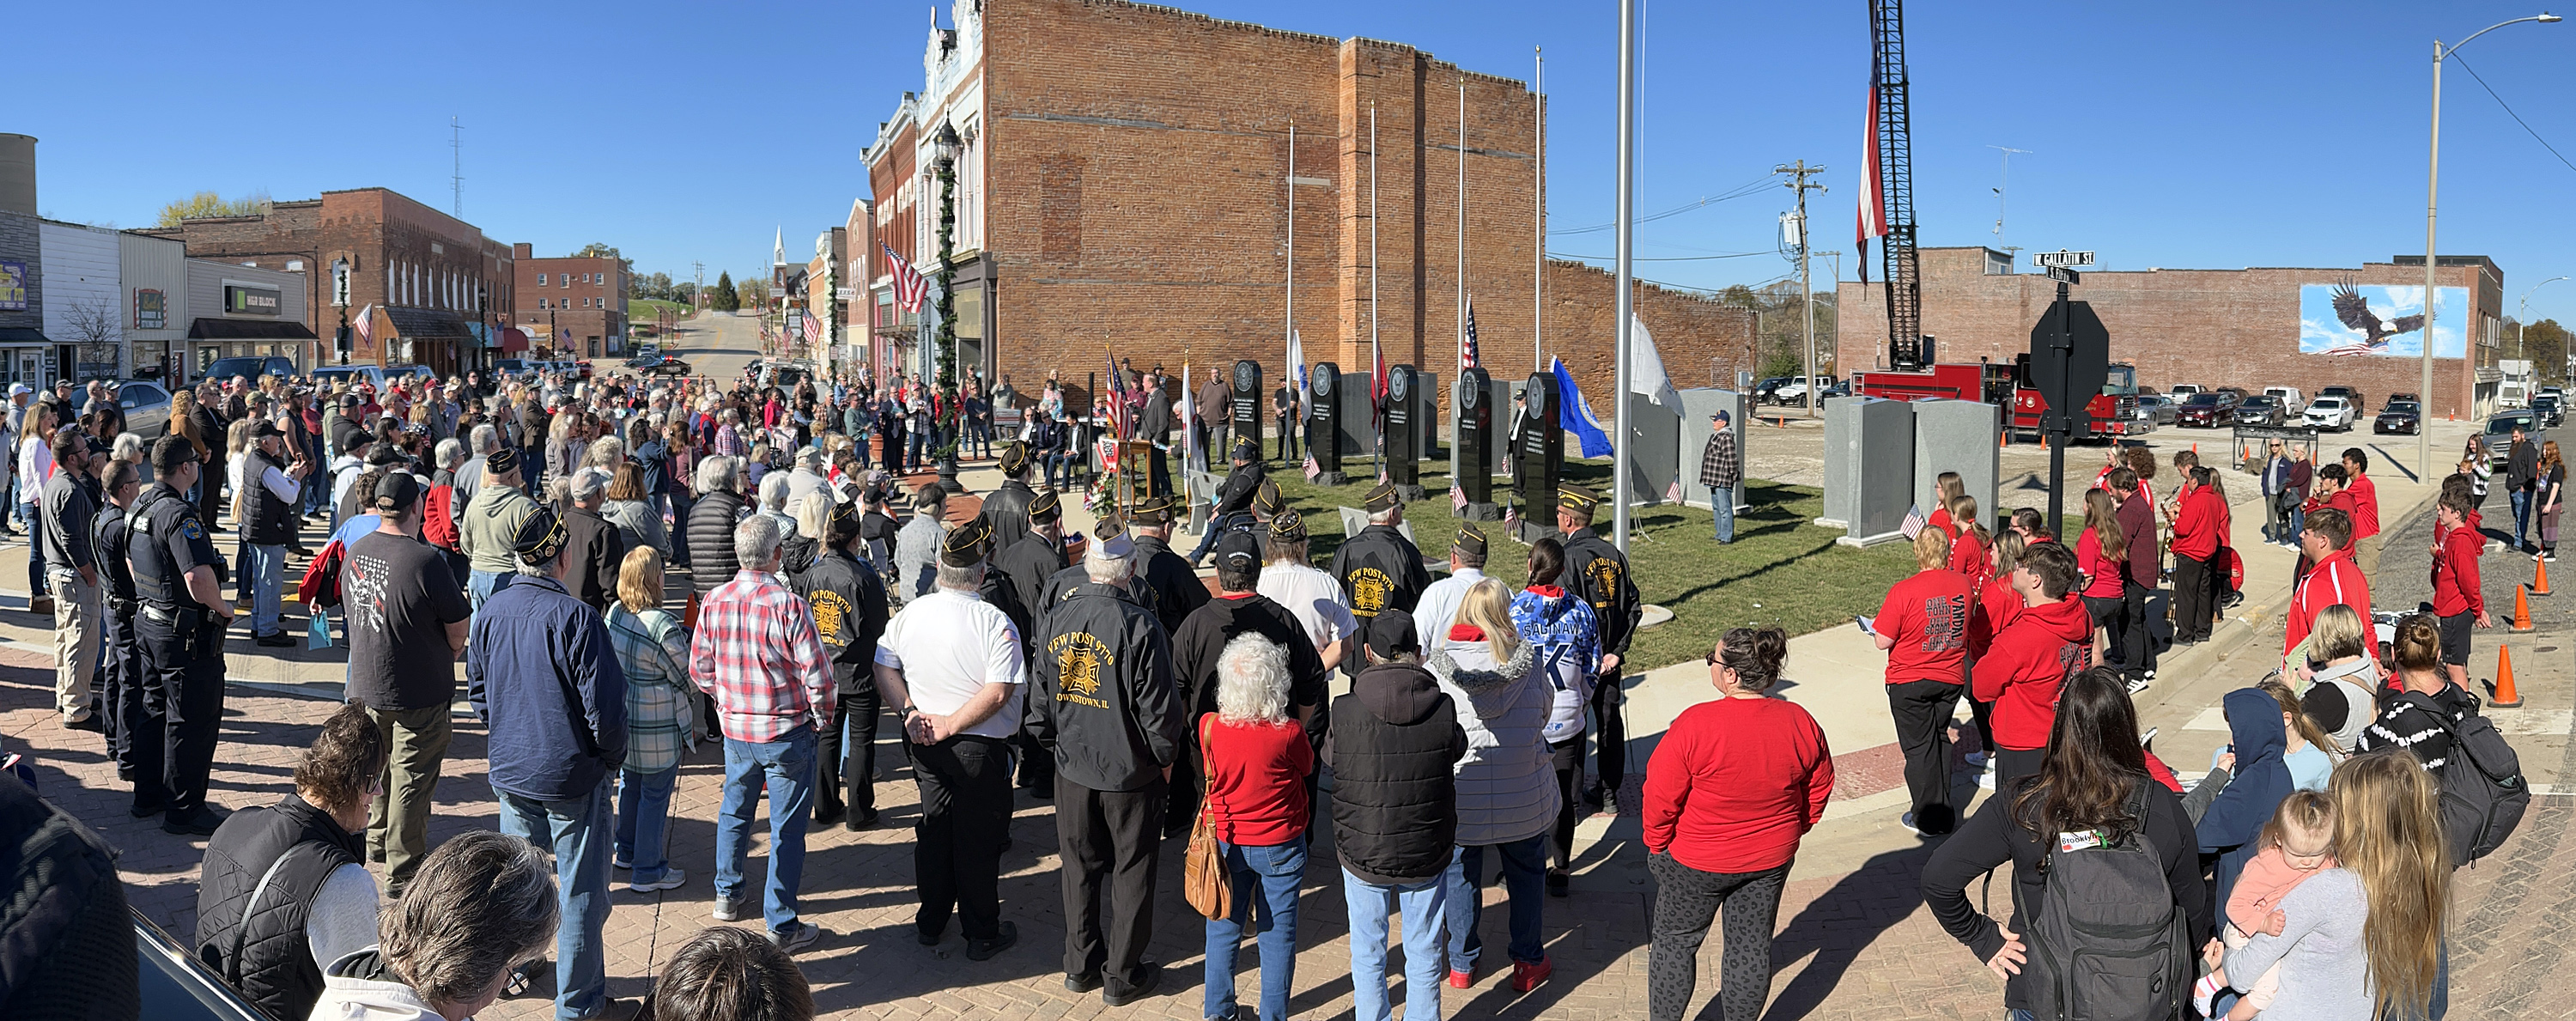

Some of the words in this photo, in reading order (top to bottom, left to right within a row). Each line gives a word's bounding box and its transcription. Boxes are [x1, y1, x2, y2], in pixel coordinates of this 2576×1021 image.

[2044, 252, 2081, 265] GALLATIN
[258, 296, 276, 307] BLOCK
[1347, 568, 1363, 583] VFW
[1363, 567, 1382, 580] POST
[1382, 574, 1395, 592] 9770
[819, 589, 837, 602] POST
[836, 594, 852, 614] 9770
[1926, 596, 1947, 608] ONE
[1925, 605, 1951, 617] TOWN
[1951, 593, 1965, 641] VANDAL
[1929, 617, 1950, 628] ONE
[1522, 622, 1581, 637] SAGINAW
[1924, 623, 1953, 635] SCHOOL
[1047, 632, 1069, 654] VFW
[1070, 631, 1096, 648] POST
[1095, 640, 1115, 666] 9770
[1101, 699, 1110, 709] IL
[2062, 834, 2098, 844] Brooklyn
